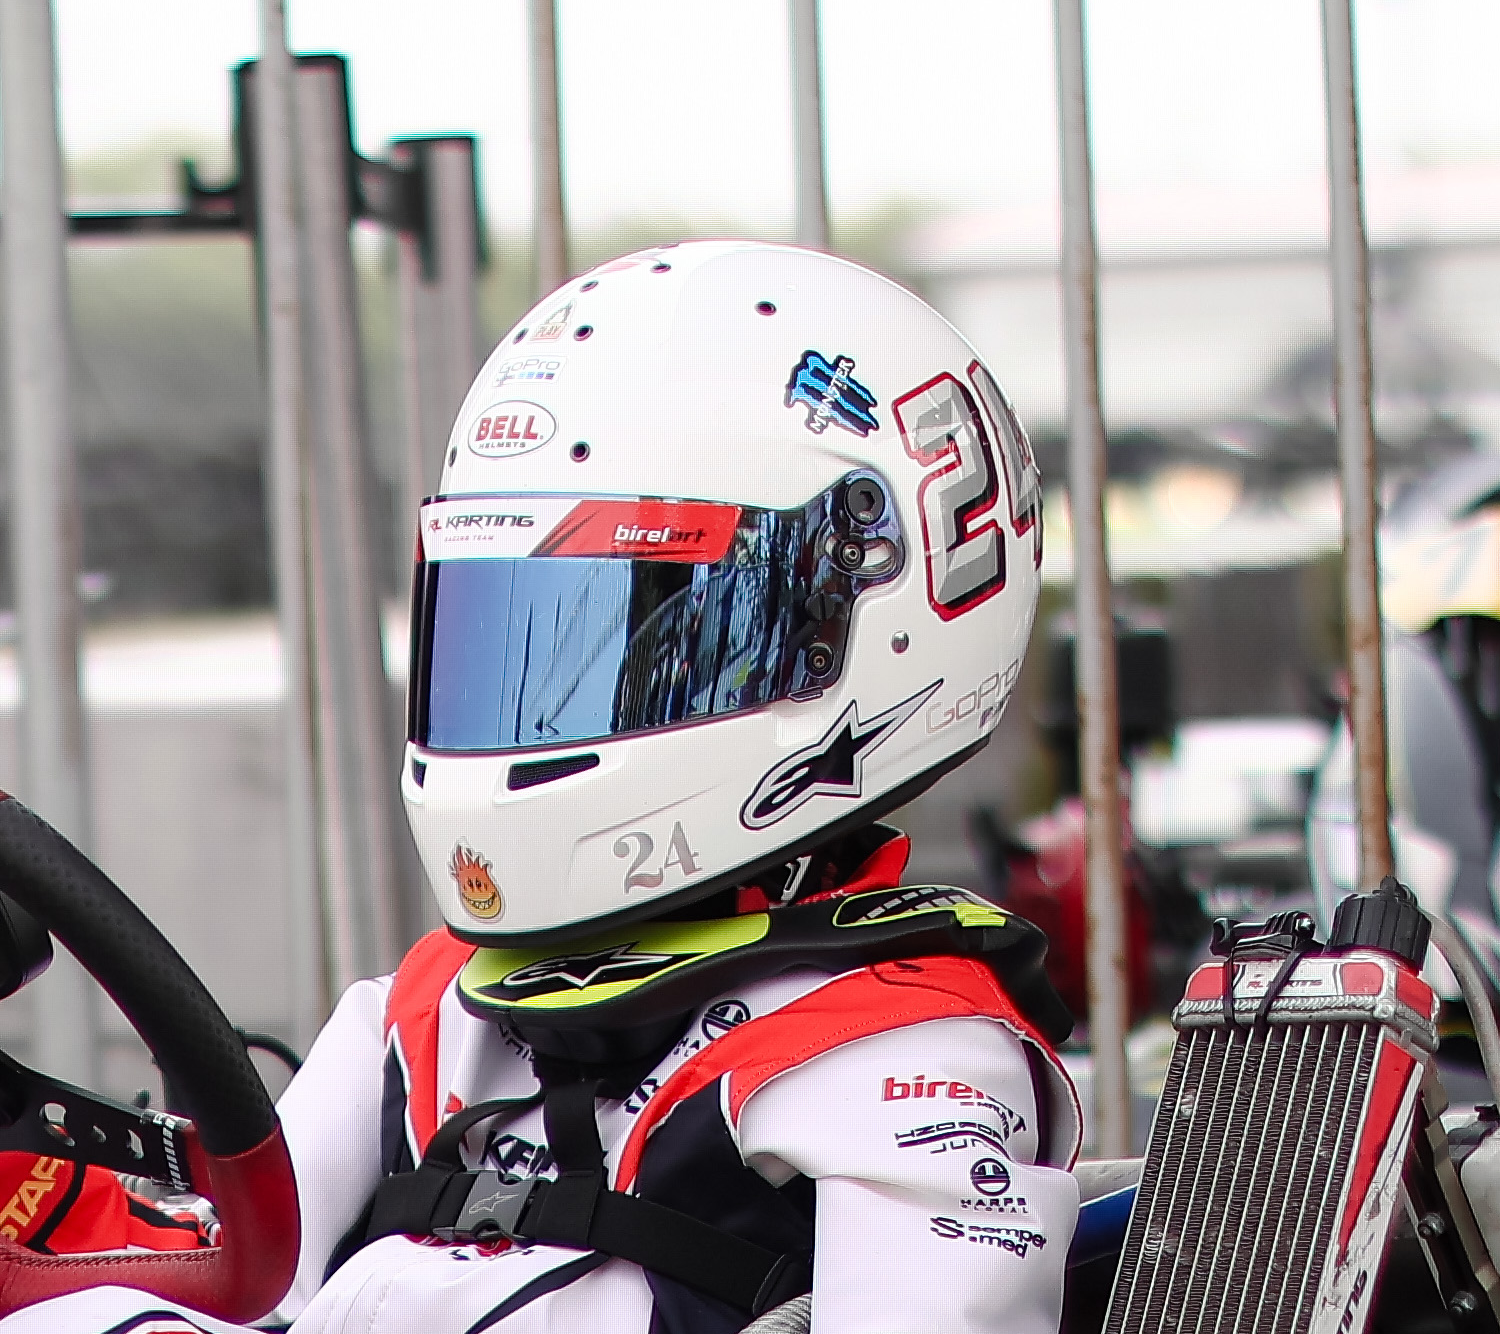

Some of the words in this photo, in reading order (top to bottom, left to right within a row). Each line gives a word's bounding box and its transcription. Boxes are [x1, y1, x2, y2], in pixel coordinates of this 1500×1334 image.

[809, 358, 856, 433] MONSTER
[474, 414, 540, 442] BELL
[445, 514, 535, 530] KARTING
[614, 524, 707, 544] birelart
[612, 820, 704, 894] 24
